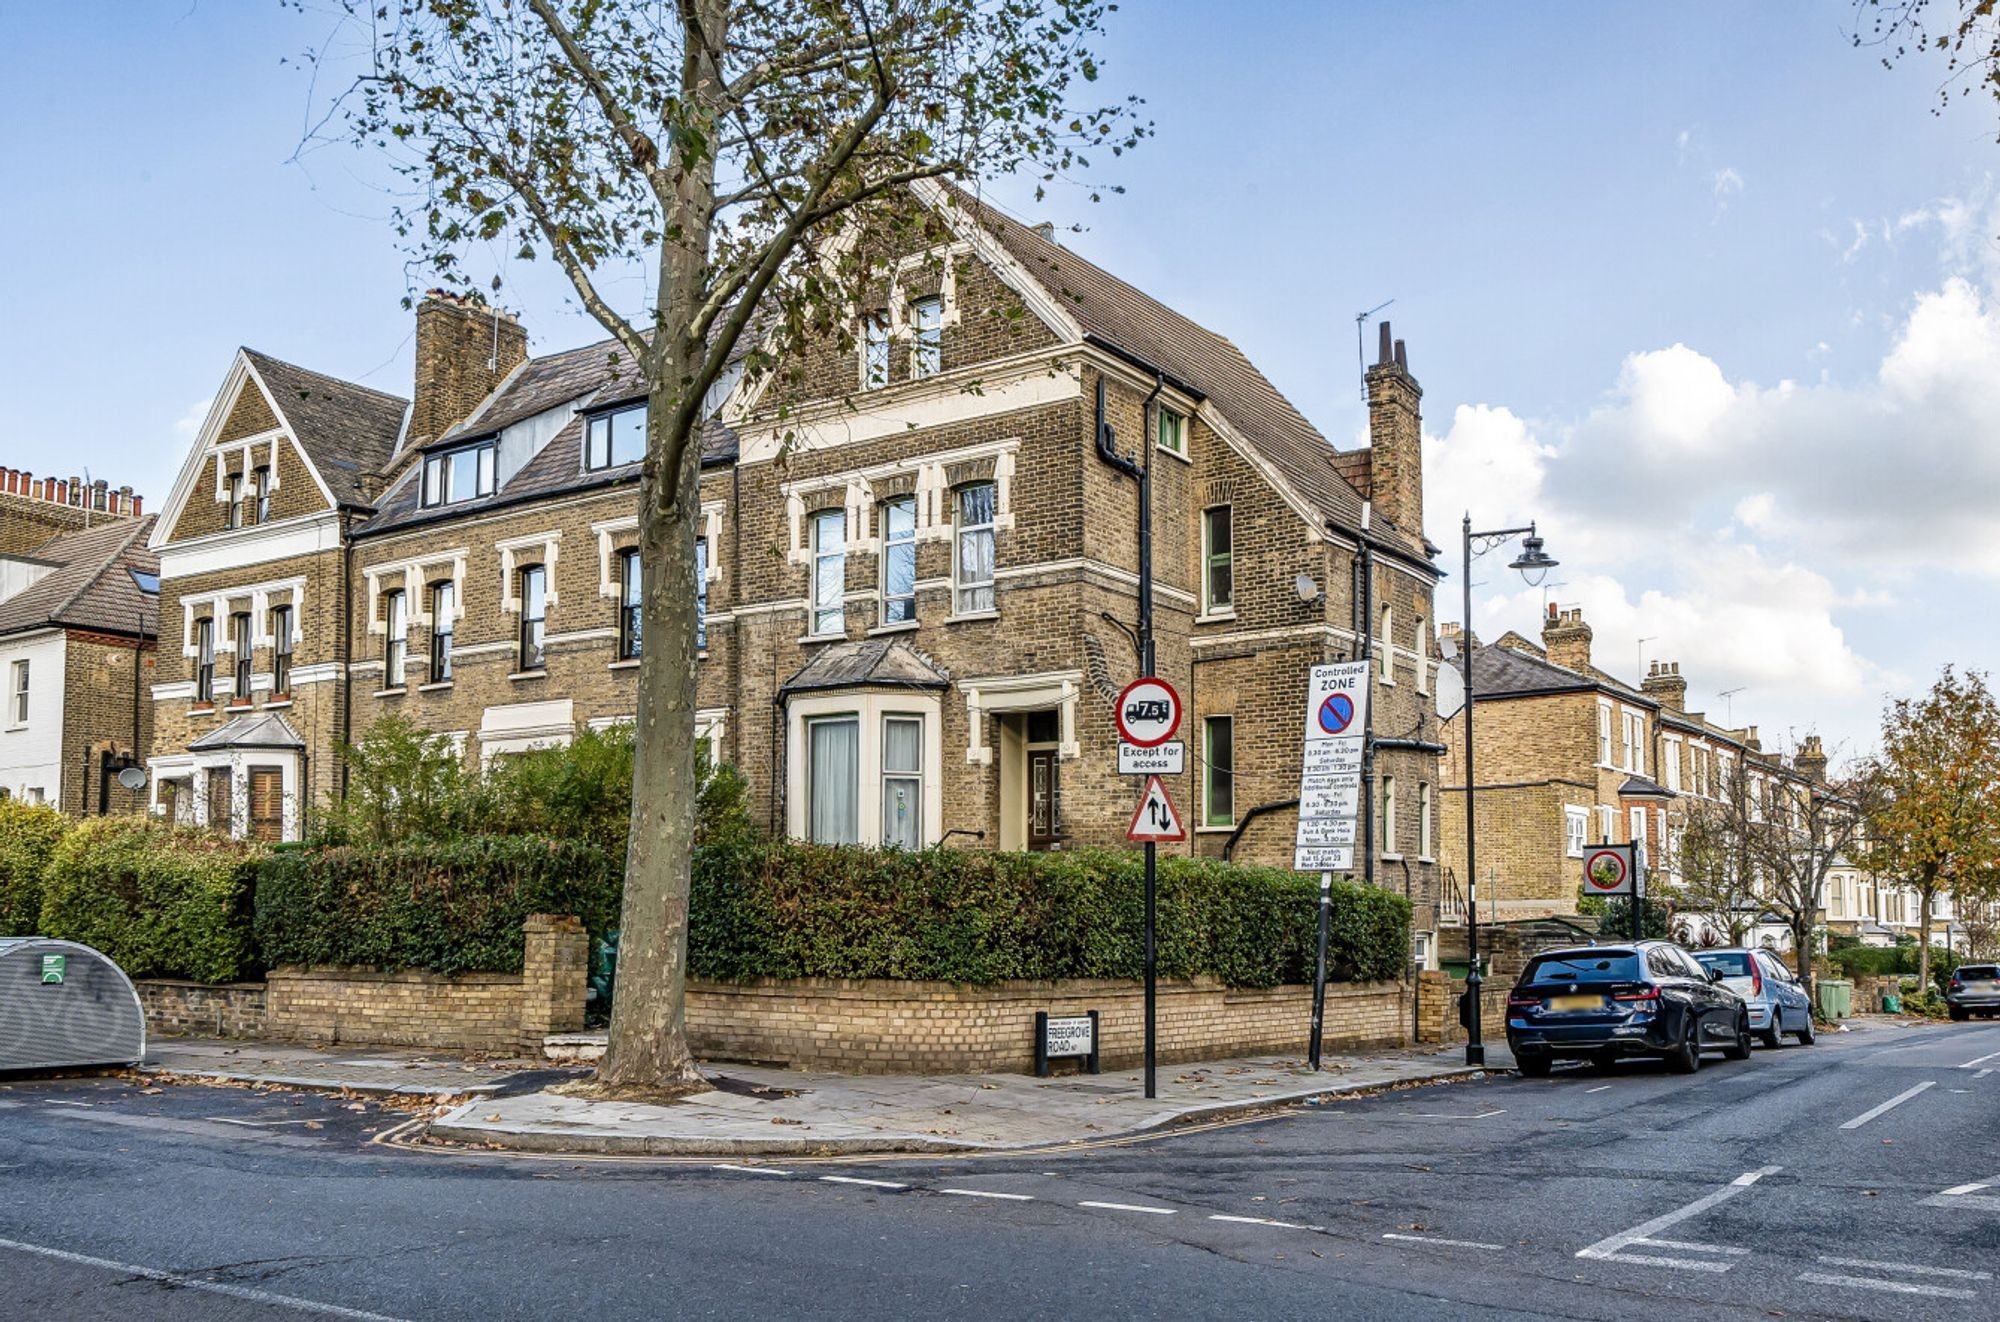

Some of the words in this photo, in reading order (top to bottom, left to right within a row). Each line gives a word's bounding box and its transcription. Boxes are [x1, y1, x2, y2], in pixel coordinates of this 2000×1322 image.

[1315, 665, 1365, 678] Controlled
[1321, 678, 1356, 691] ZONE
[1123, 747, 1159, 758] Except
[1163, 746, 1179, 756] for
[1132, 760, 1168, 768] access
[1048, 1026, 1089, 1039] FREEGROVE
[1048, 1040, 1070, 1053] ROAD
